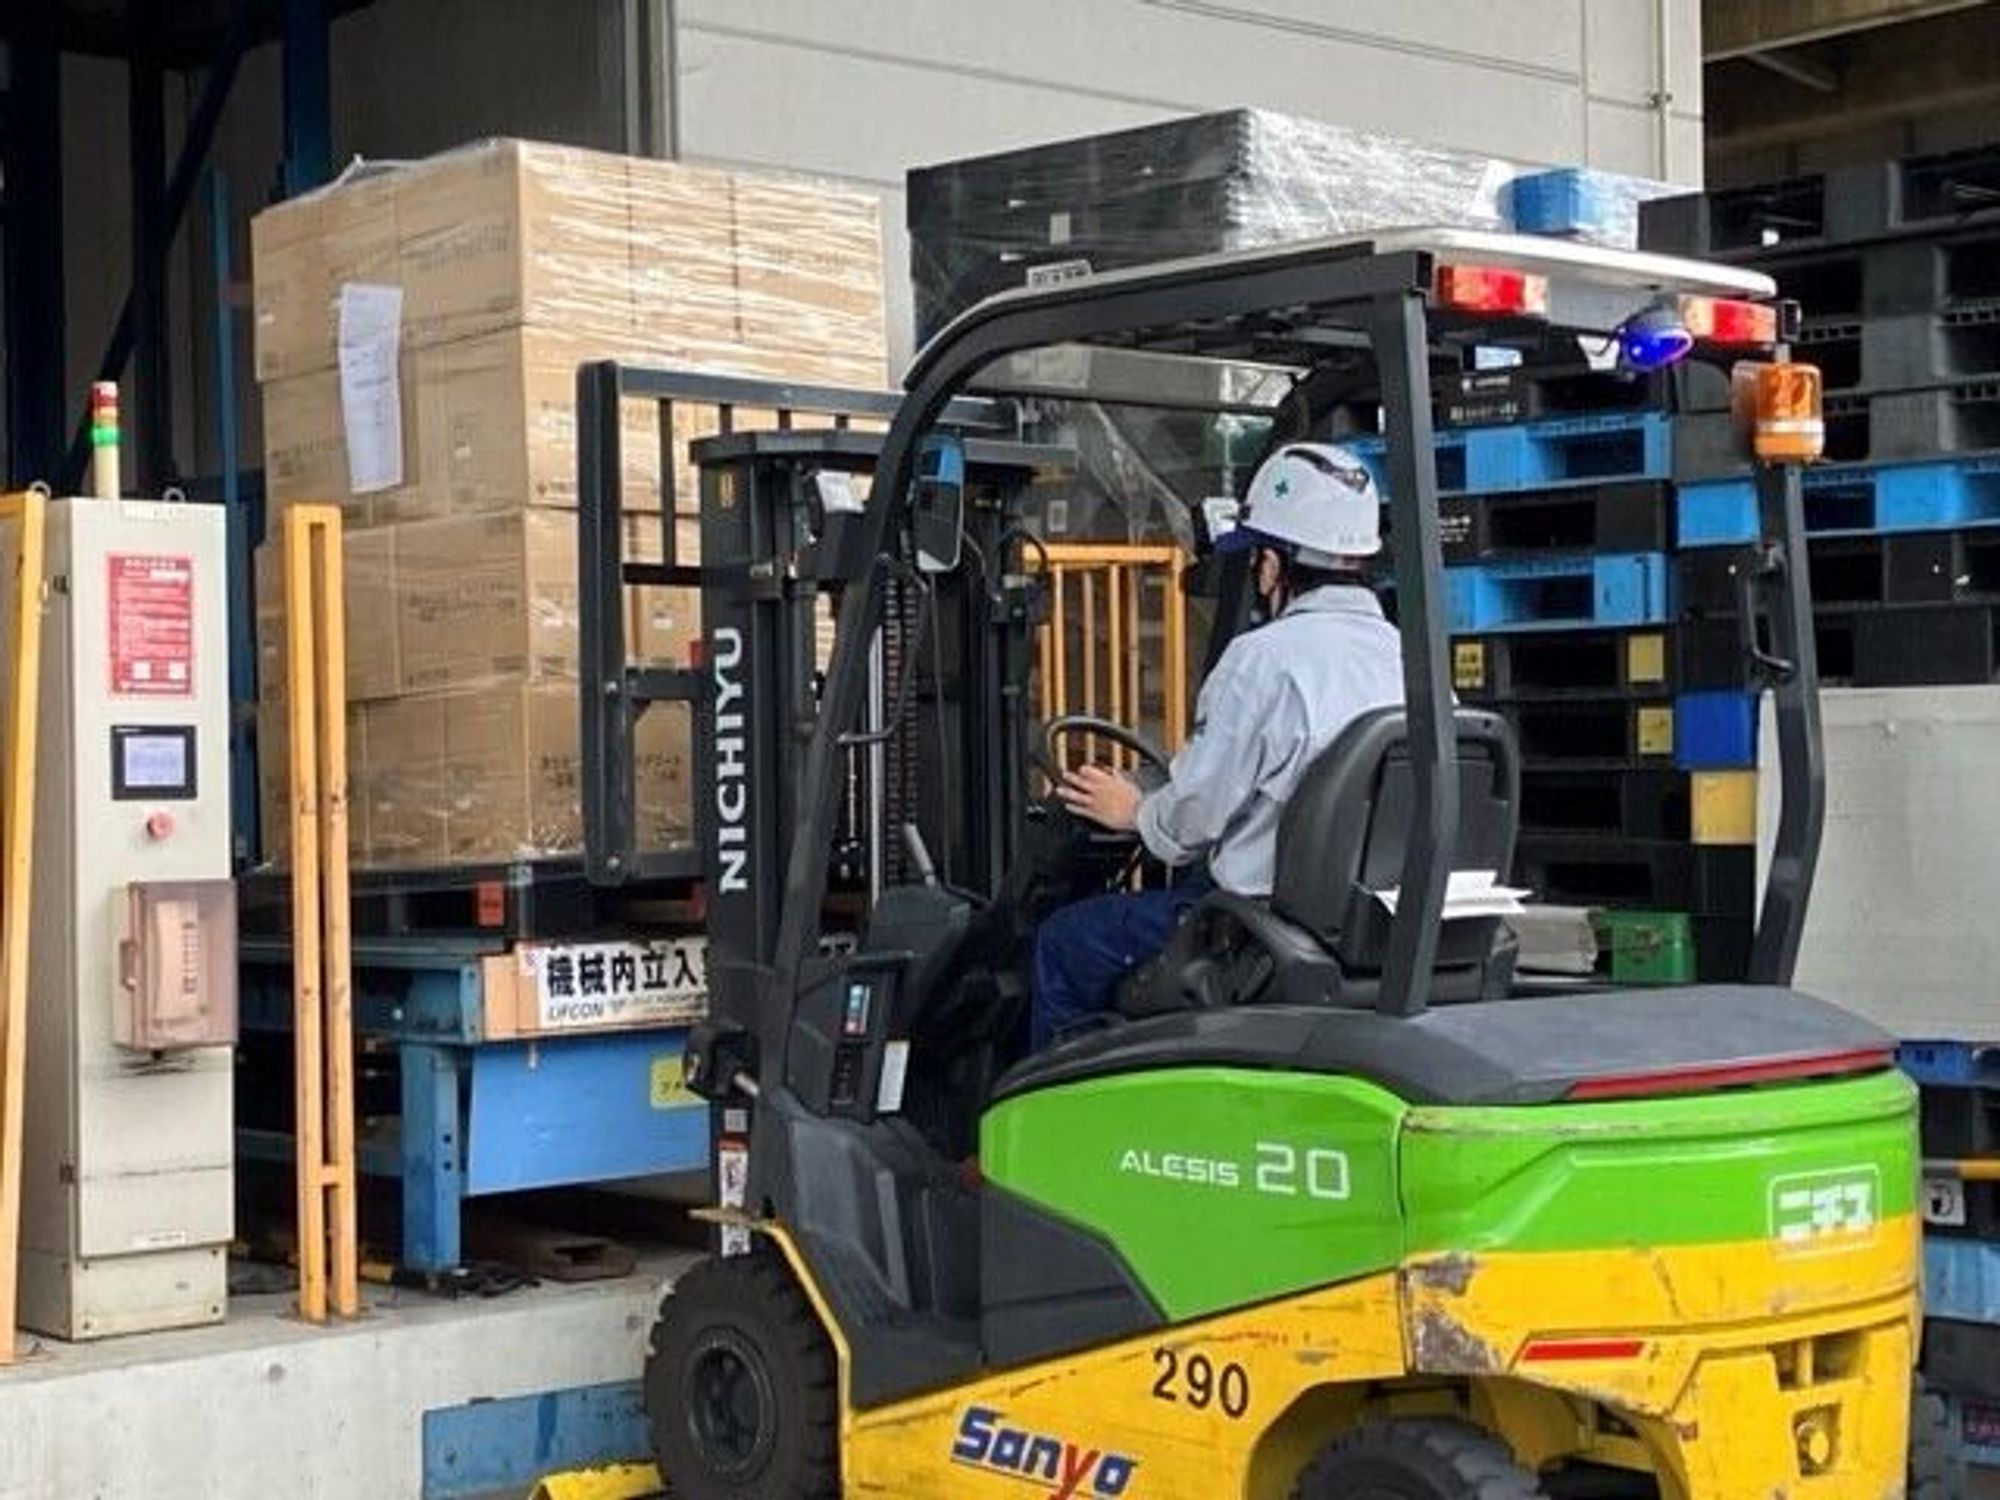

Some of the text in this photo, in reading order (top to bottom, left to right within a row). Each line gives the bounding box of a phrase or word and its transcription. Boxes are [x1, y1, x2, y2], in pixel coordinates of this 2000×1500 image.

[714, 627, 748, 894] NICHIYU
[547, 947, 709, 997] 機械内立入
[1119, 1141, 1351, 1201] ALESIS 20
[1152, 1347, 1249, 1418] 290
[952, 1406, 1138, 1500] Sanyo
